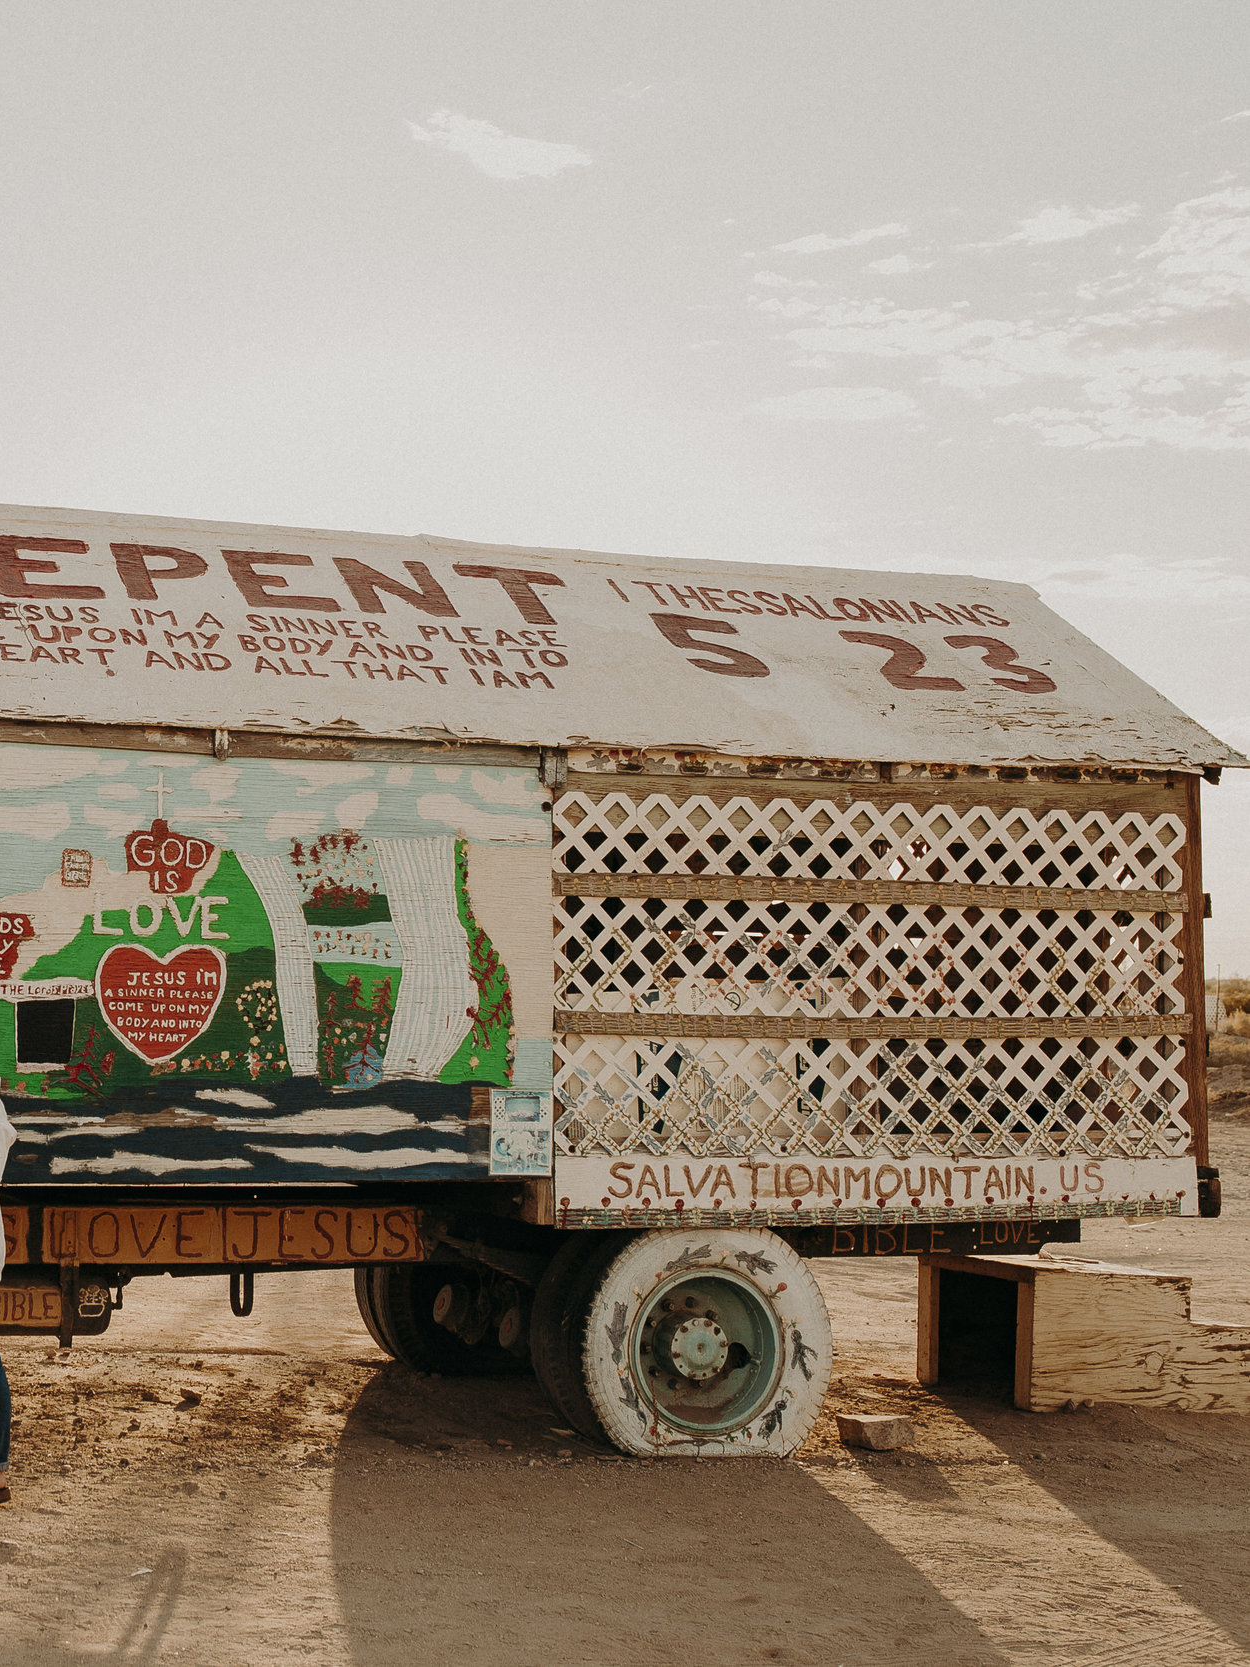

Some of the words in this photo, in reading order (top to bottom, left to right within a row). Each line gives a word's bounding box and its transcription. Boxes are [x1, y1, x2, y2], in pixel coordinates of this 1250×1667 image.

[631, 580, 1010, 628] THESSALONIANS
[27, 624, 148, 647] UPON
[163, 630, 220, 650] MY
[237, 634, 333, 656] BODY
[347, 642, 434, 662] AND
[195, 612, 224, 629] A
[246, 614, 389, 639] SINNER
[417, 625, 568, 648] PLEASE
[649, 612, 770, 678] 5
[145, 650, 232, 672] AND
[254, 656, 329, 678] ALL
[330, 660, 450, 685] THAT
[492, 670, 555, 690] AM
[131, 834, 207, 870] GOD
[152, 871, 178, 892] IS
[91, 896, 230, 940] LOVE
[0, 984, 24, 995] THE
[104, 988, 113, 998] A
[117, 988, 165, 998] SINNER
[170, 989, 213, 999] PLEASE
[126, 970, 187, 986] JESUS
[108, 1001, 144, 1012] COME
[151, 1003, 185, 1014] UPON
[188, 1004, 210, 1015] MY
[116, 1016, 150, 1028] BODY
[150, 1019, 176, 1028] AND
[178, 1019, 203, 1029] INTO
[128, 1031, 146, 1042] MY
[149, 1032, 188, 1042] HEART
[49, 1207, 206, 1261] LOVE
[231, 1209, 411, 1261] JESUS
[831, 1224, 953, 1255] BIBLE
[979, 1220, 1042, 1245] LOVE
